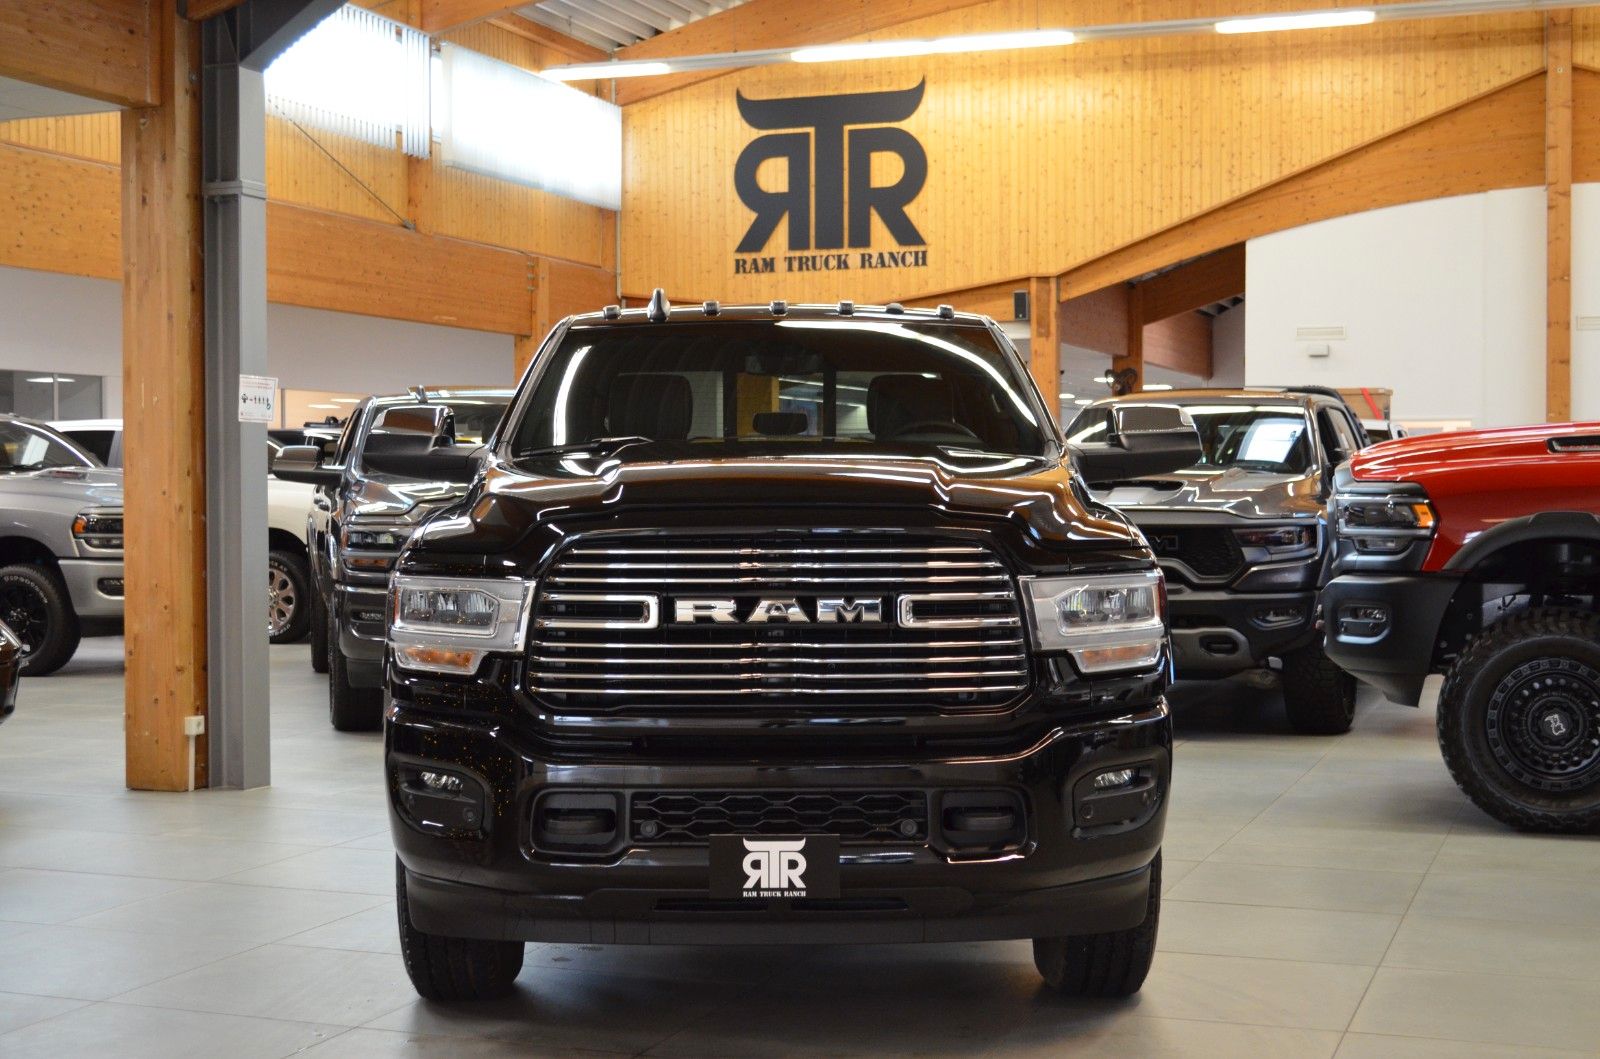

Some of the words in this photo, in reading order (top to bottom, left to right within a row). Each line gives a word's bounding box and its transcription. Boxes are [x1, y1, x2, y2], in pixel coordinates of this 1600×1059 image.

[734, 257, 775, 275] RAM
[784, 253, 850, 273] TRUCK
[859, 250, 928, 269] RANCH
[674, 597, 882, 623] RAM
